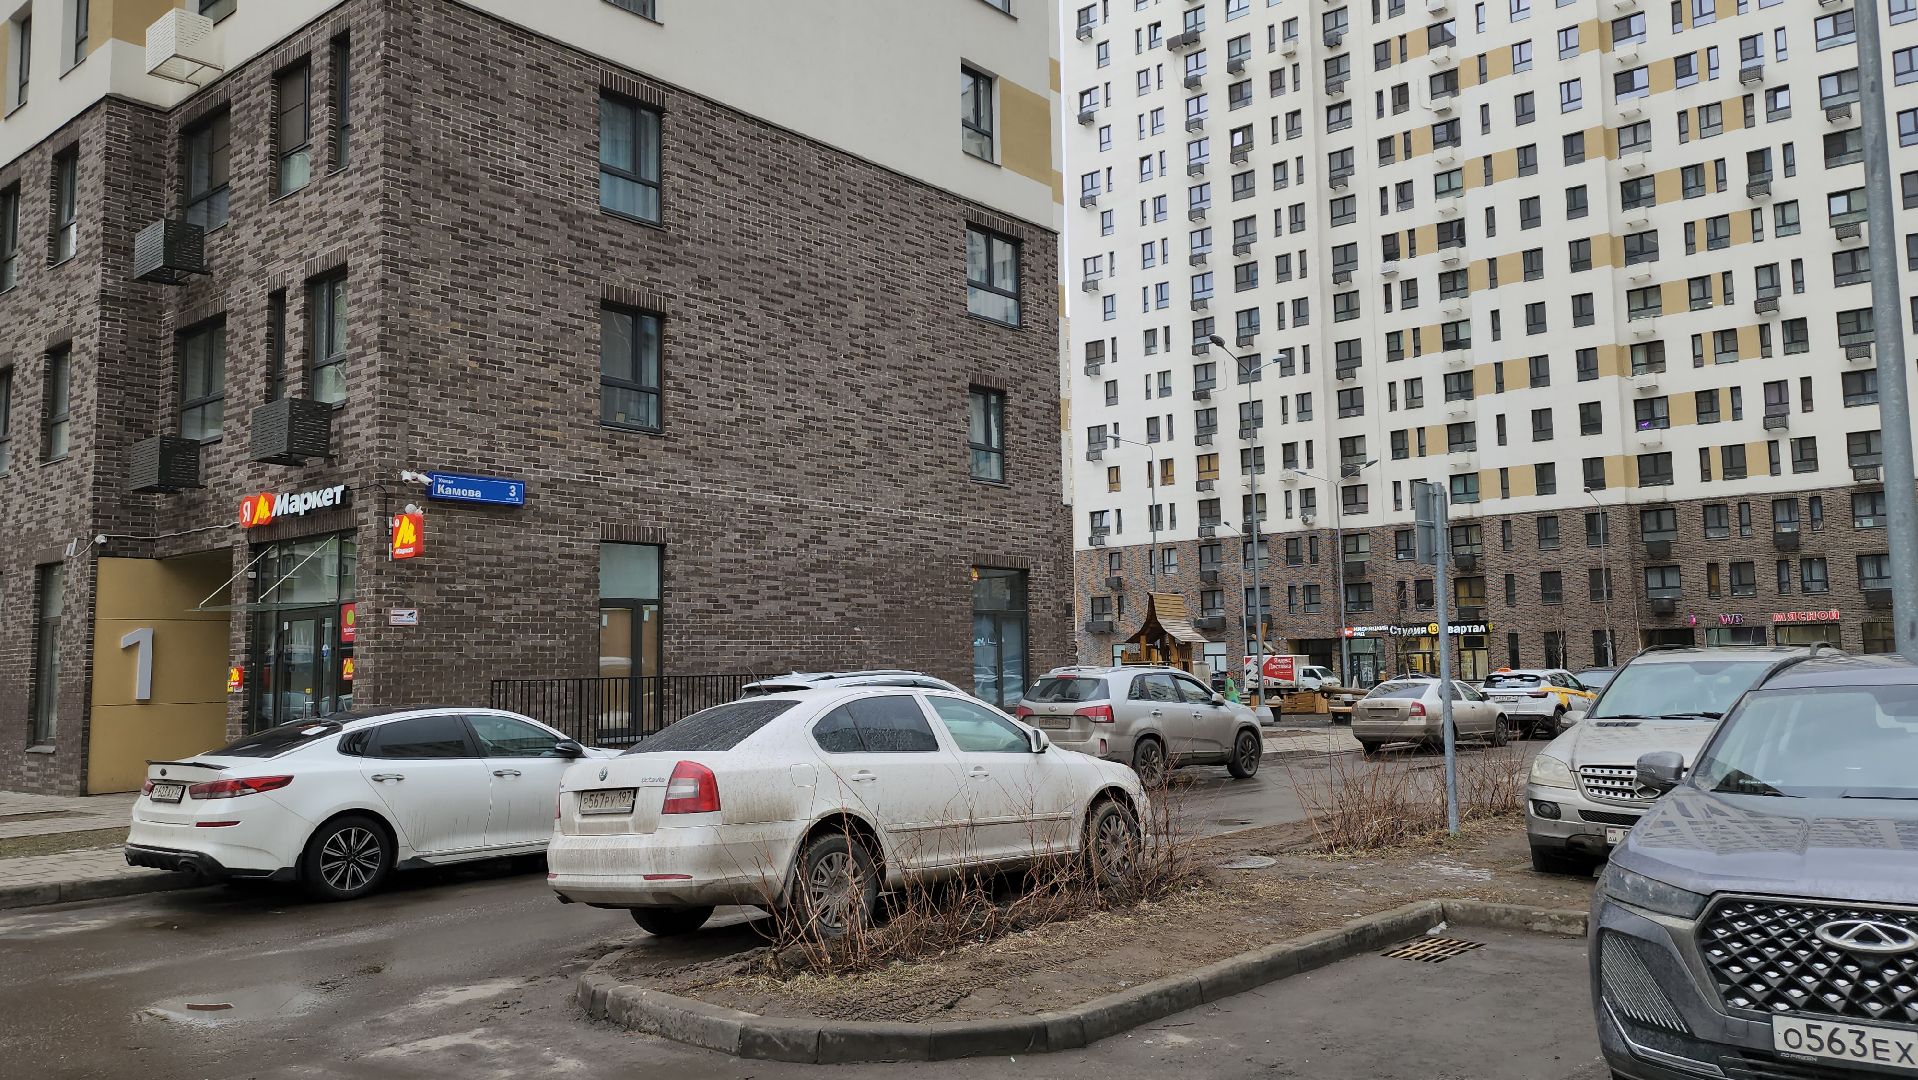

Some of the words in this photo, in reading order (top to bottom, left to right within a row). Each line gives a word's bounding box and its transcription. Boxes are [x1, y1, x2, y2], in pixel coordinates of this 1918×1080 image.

[437, 484, 481, 497] Камова
[509, 485, 516, 497] 3
[242, 501, 250, 523] Я
[271, 485, 345, 517] Маркет
[1719, 613, 1743, 625] WB
[1773, 609, 1840, 622] МЯСНОЙ
[1389, 625, 1427, 636] Студия
[1447, 624, 1486, 635] вартал
[120, 627, 153, 700] 1
